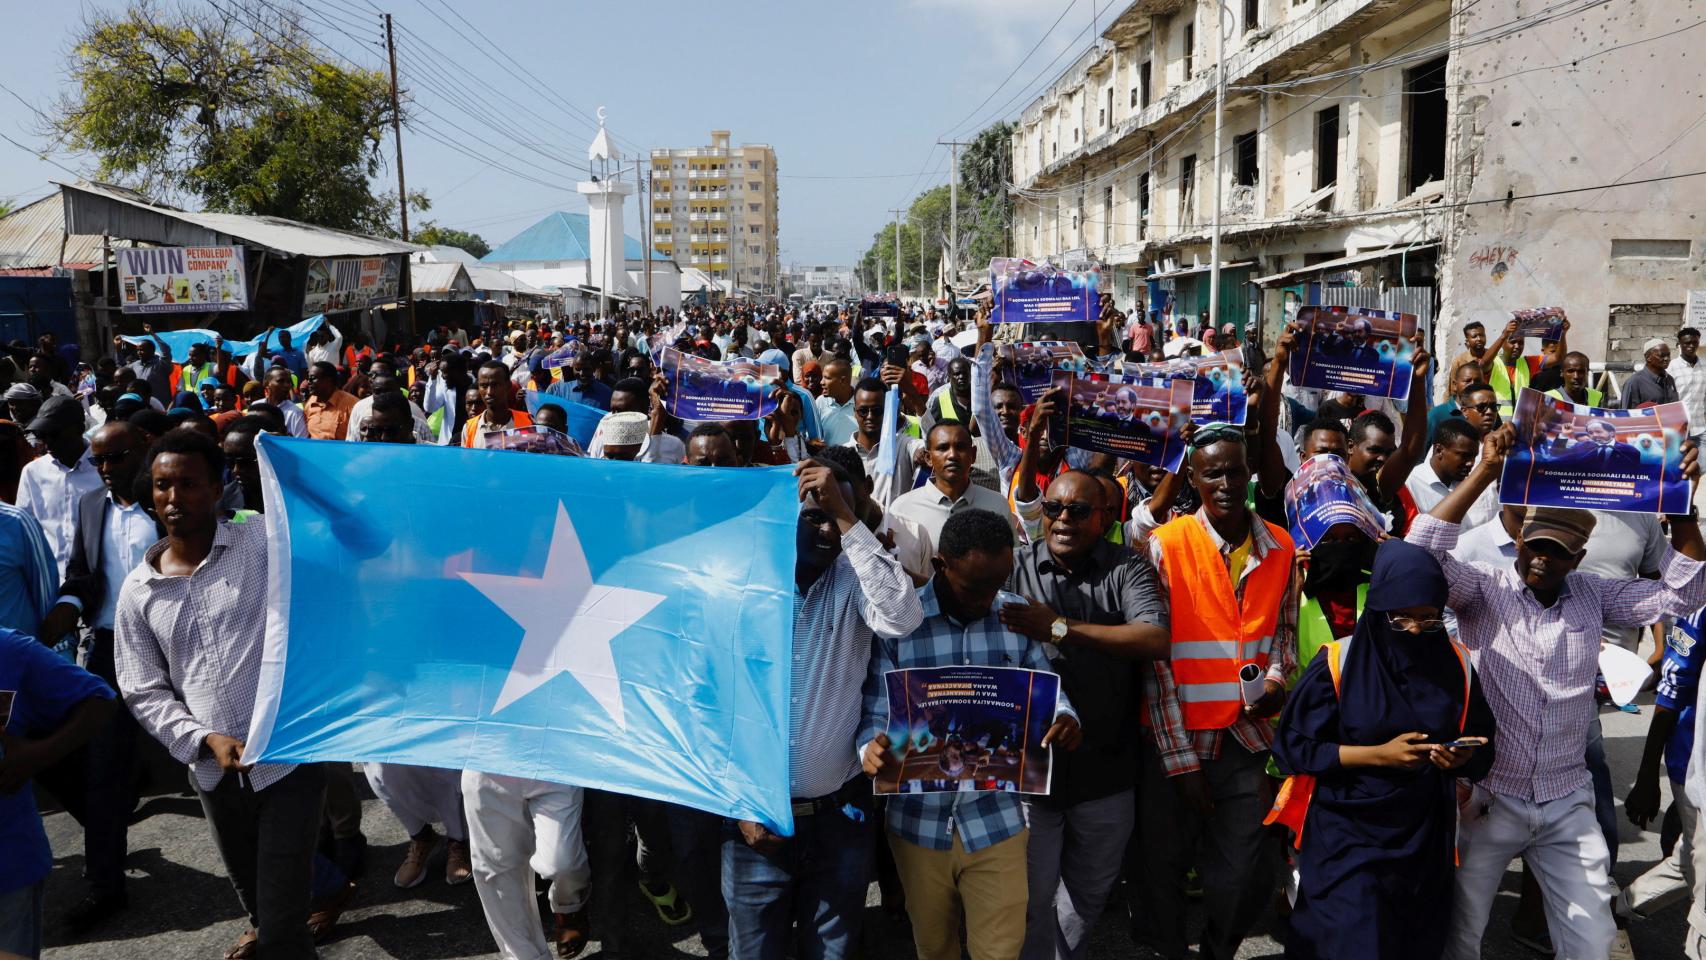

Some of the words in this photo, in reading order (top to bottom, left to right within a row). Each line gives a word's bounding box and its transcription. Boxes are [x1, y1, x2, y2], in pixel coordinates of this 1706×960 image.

[126, 248, 184, 275] WIIN
[186, 248, 232, 258] PETROLEUM
[188, 260, 228, 270] COMPANY
[336, 260, 361, 291] WIIN
